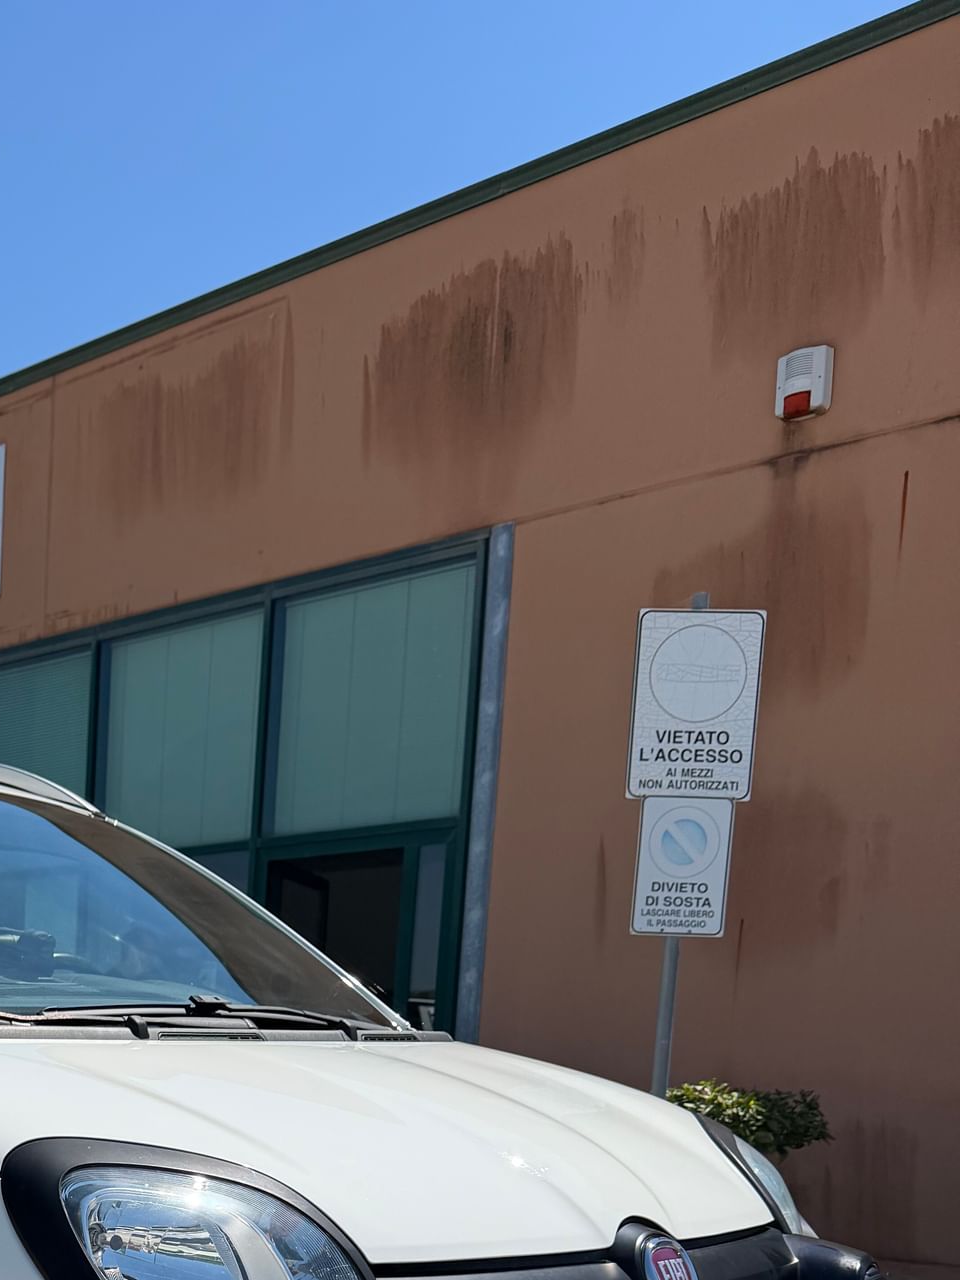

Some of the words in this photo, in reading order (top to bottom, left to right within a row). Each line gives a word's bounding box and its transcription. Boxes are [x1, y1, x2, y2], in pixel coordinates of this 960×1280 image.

[656, 730, 730, 745] VIETATO
[639, 748, 743, 764] L'ACCESSO
[666, 768, 677, 777] AI
[681, 768, 714, 778] MEZZI
[638, 779, 663, 789] NON
[667, 780, 739, 791] AUTORIZZATI
[651, 881, 709, 894] DIVIETO
[645, 895, 659, 906] DI
[663, 896, 711, 908] SOSTA
[640, 908, 681, 918] LASCIARE
[683, 910, 715, 919] LIBERO
[656, 919, 706, 928] PASSAGGIO
